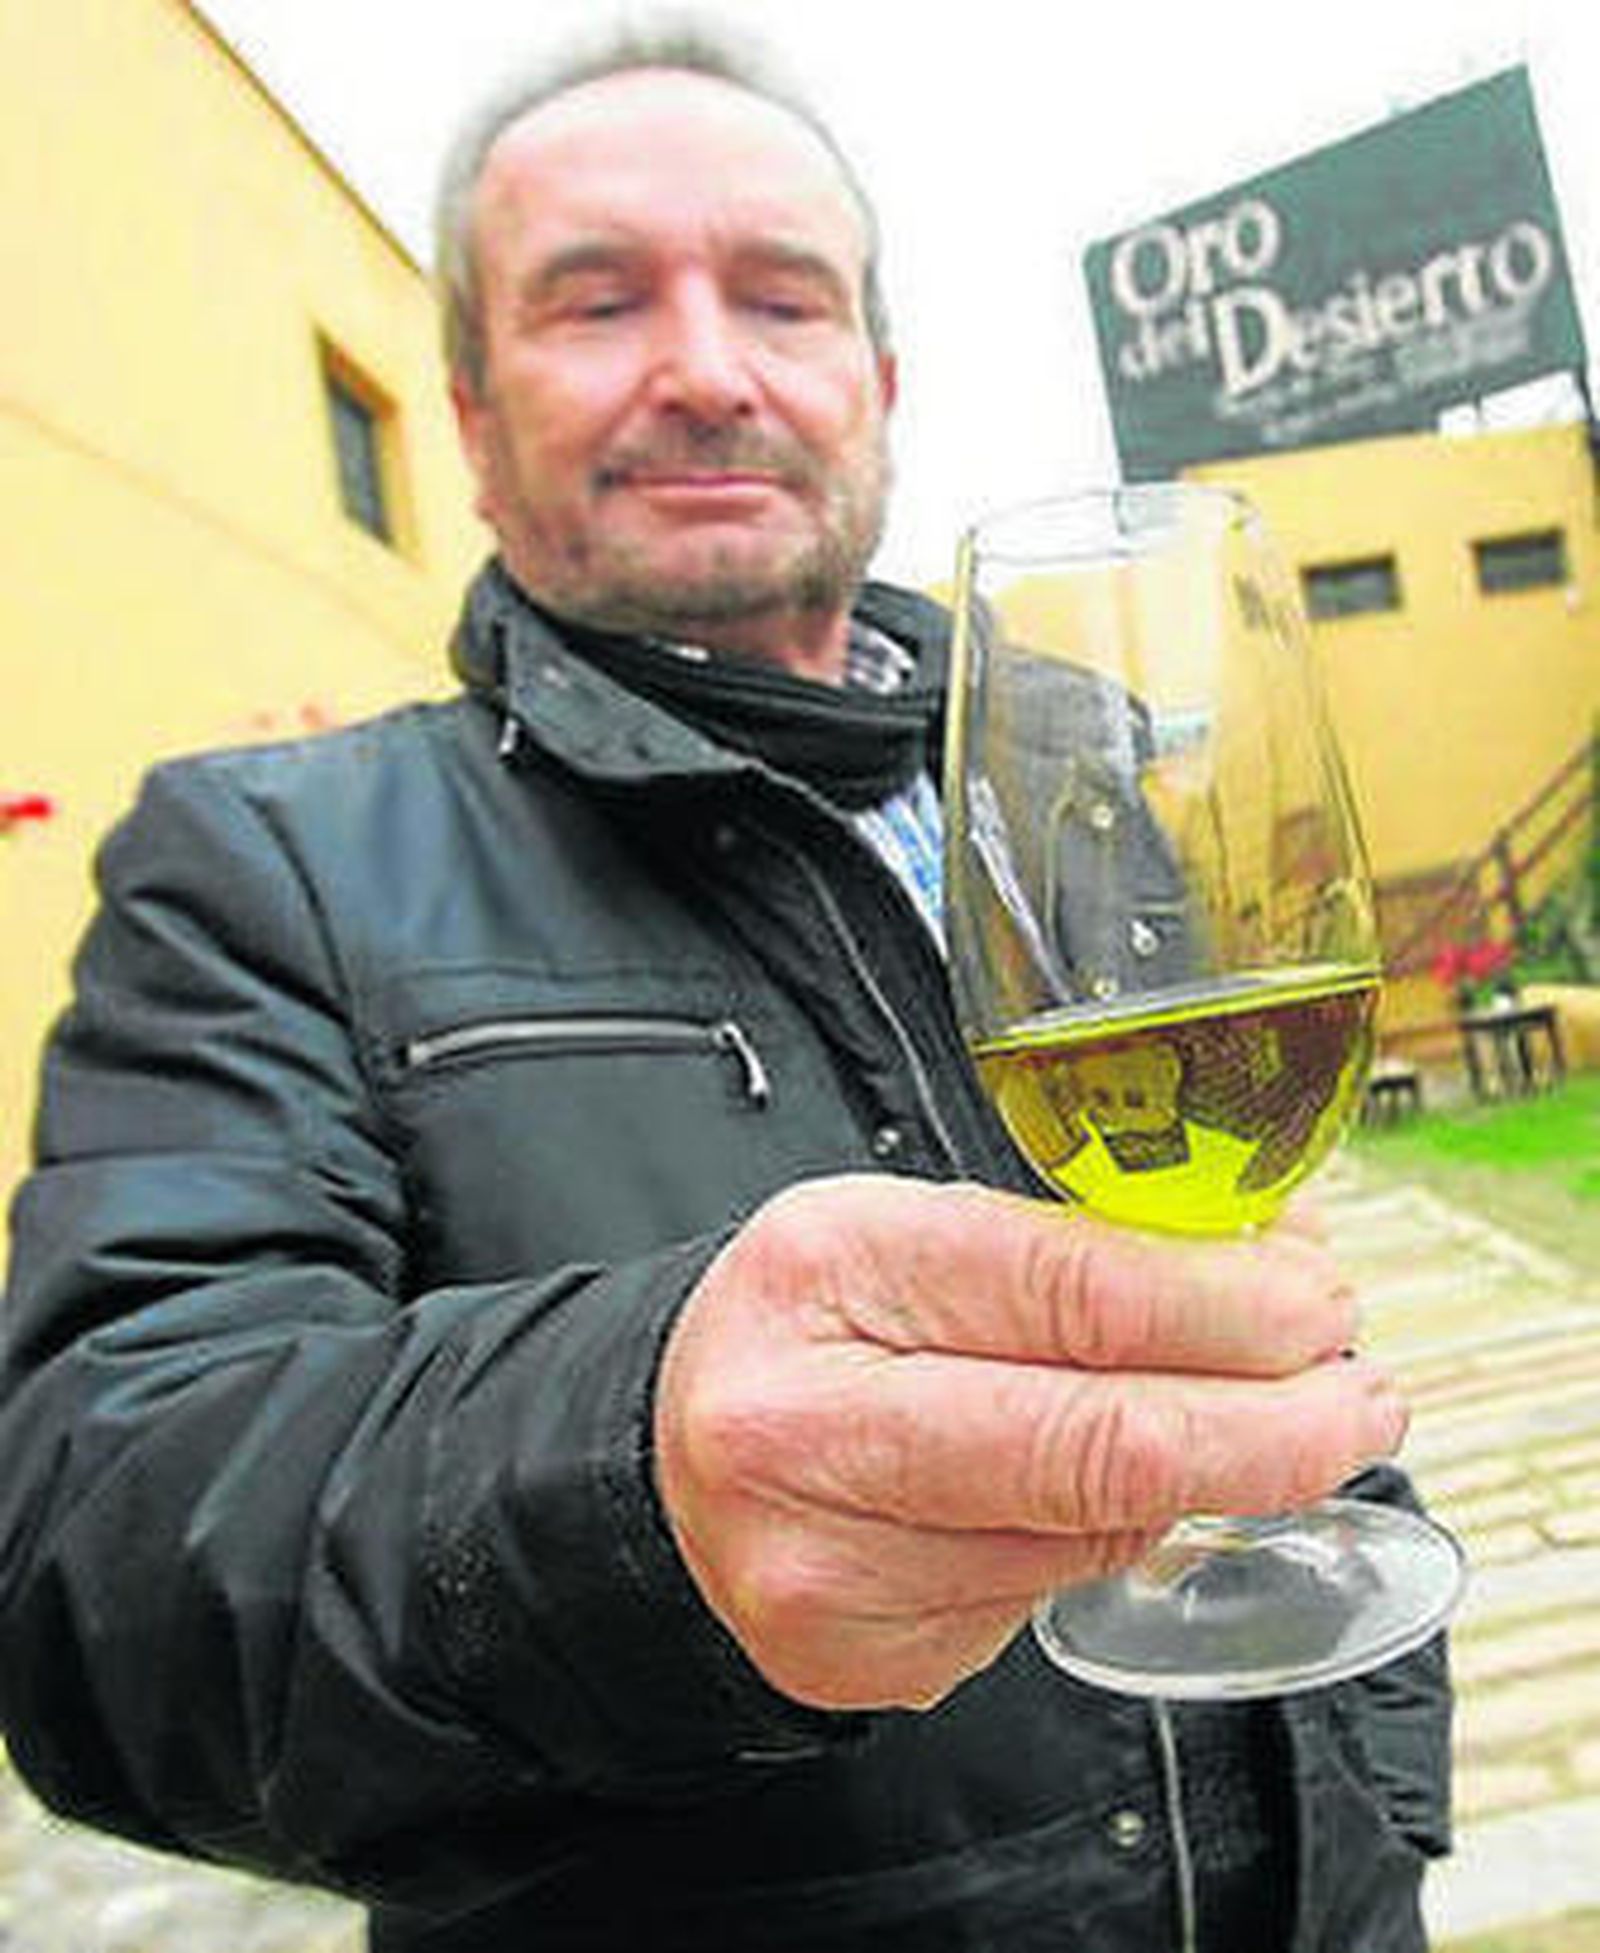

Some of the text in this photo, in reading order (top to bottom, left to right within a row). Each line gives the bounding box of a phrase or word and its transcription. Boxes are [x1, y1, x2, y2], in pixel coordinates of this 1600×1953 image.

[1111, 200, 1280, 319] Oro
[1118, 300, 1210, 380] del
[1213, 221, 1552, 396] Desierto
